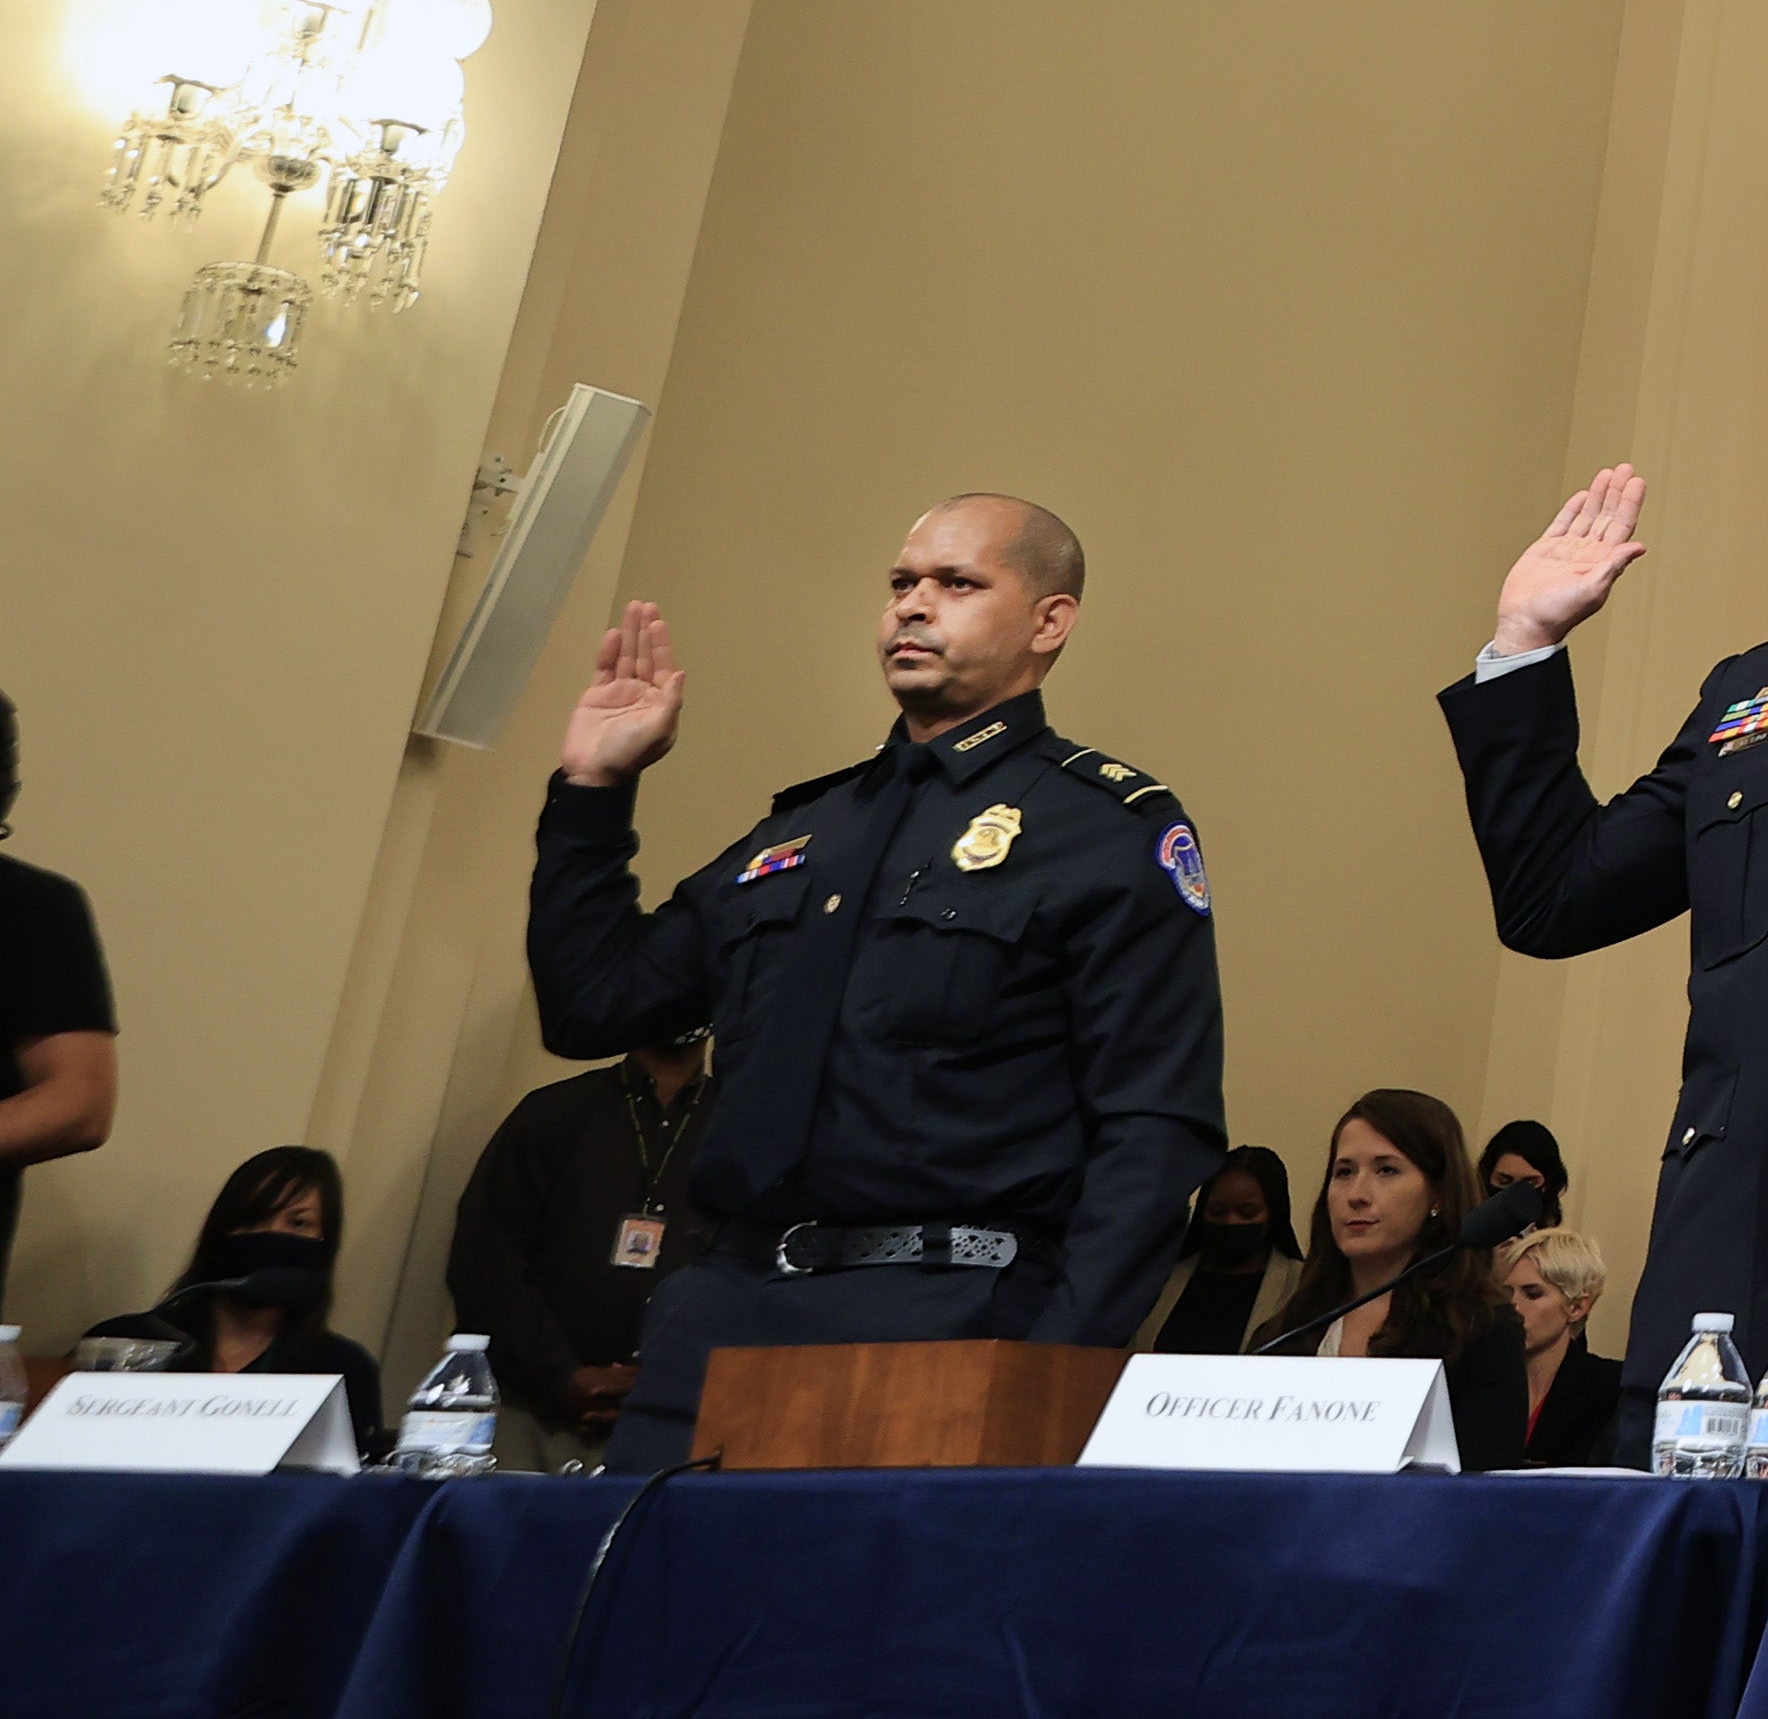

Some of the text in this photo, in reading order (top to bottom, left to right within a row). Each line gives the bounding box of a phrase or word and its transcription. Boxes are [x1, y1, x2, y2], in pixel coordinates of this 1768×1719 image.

[66, 1394, 300, 1418] SERGEANT GONELL
[1145, 1391, 1382, 1422] OFFICER FANONE
